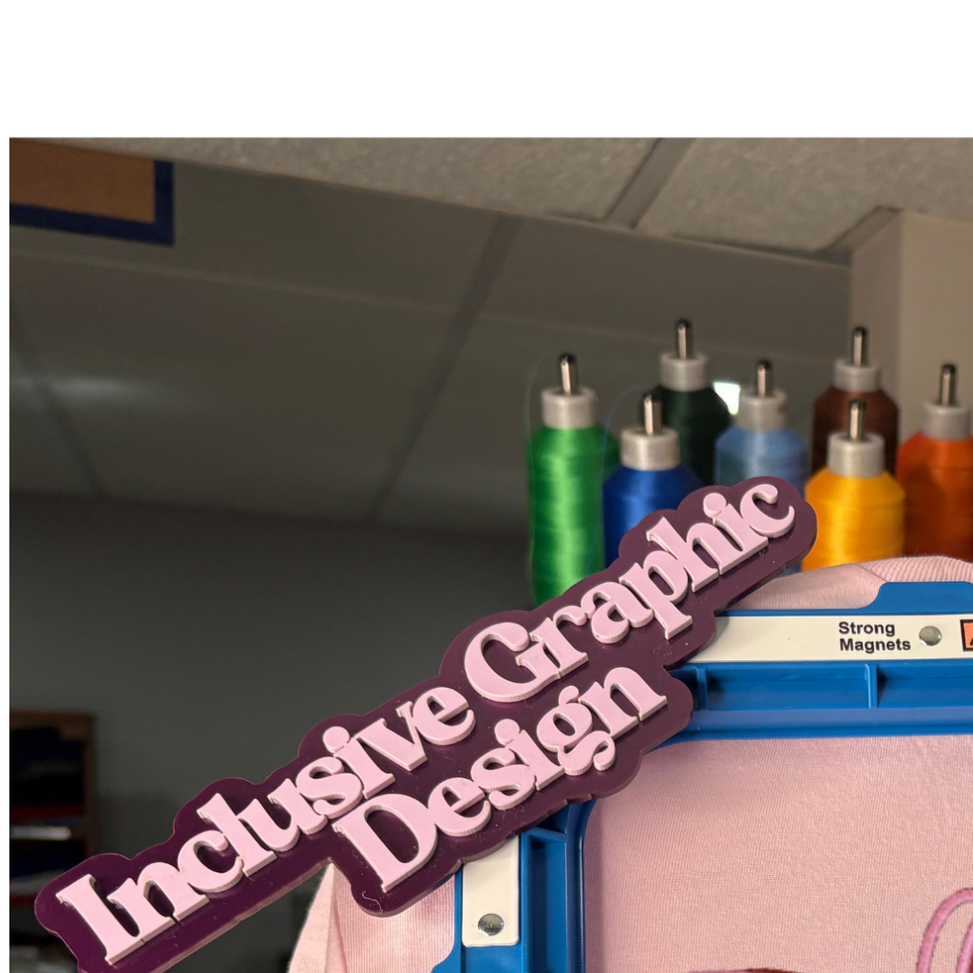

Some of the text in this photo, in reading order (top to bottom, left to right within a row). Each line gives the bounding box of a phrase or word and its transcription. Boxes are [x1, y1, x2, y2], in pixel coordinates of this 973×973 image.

[838, 621, 895, 635] Strong
[839, 637, 911, 654] Magnets
[56, 482, 796, 964] Inclusive Graphic
[332, 666, 667, 894] Design
